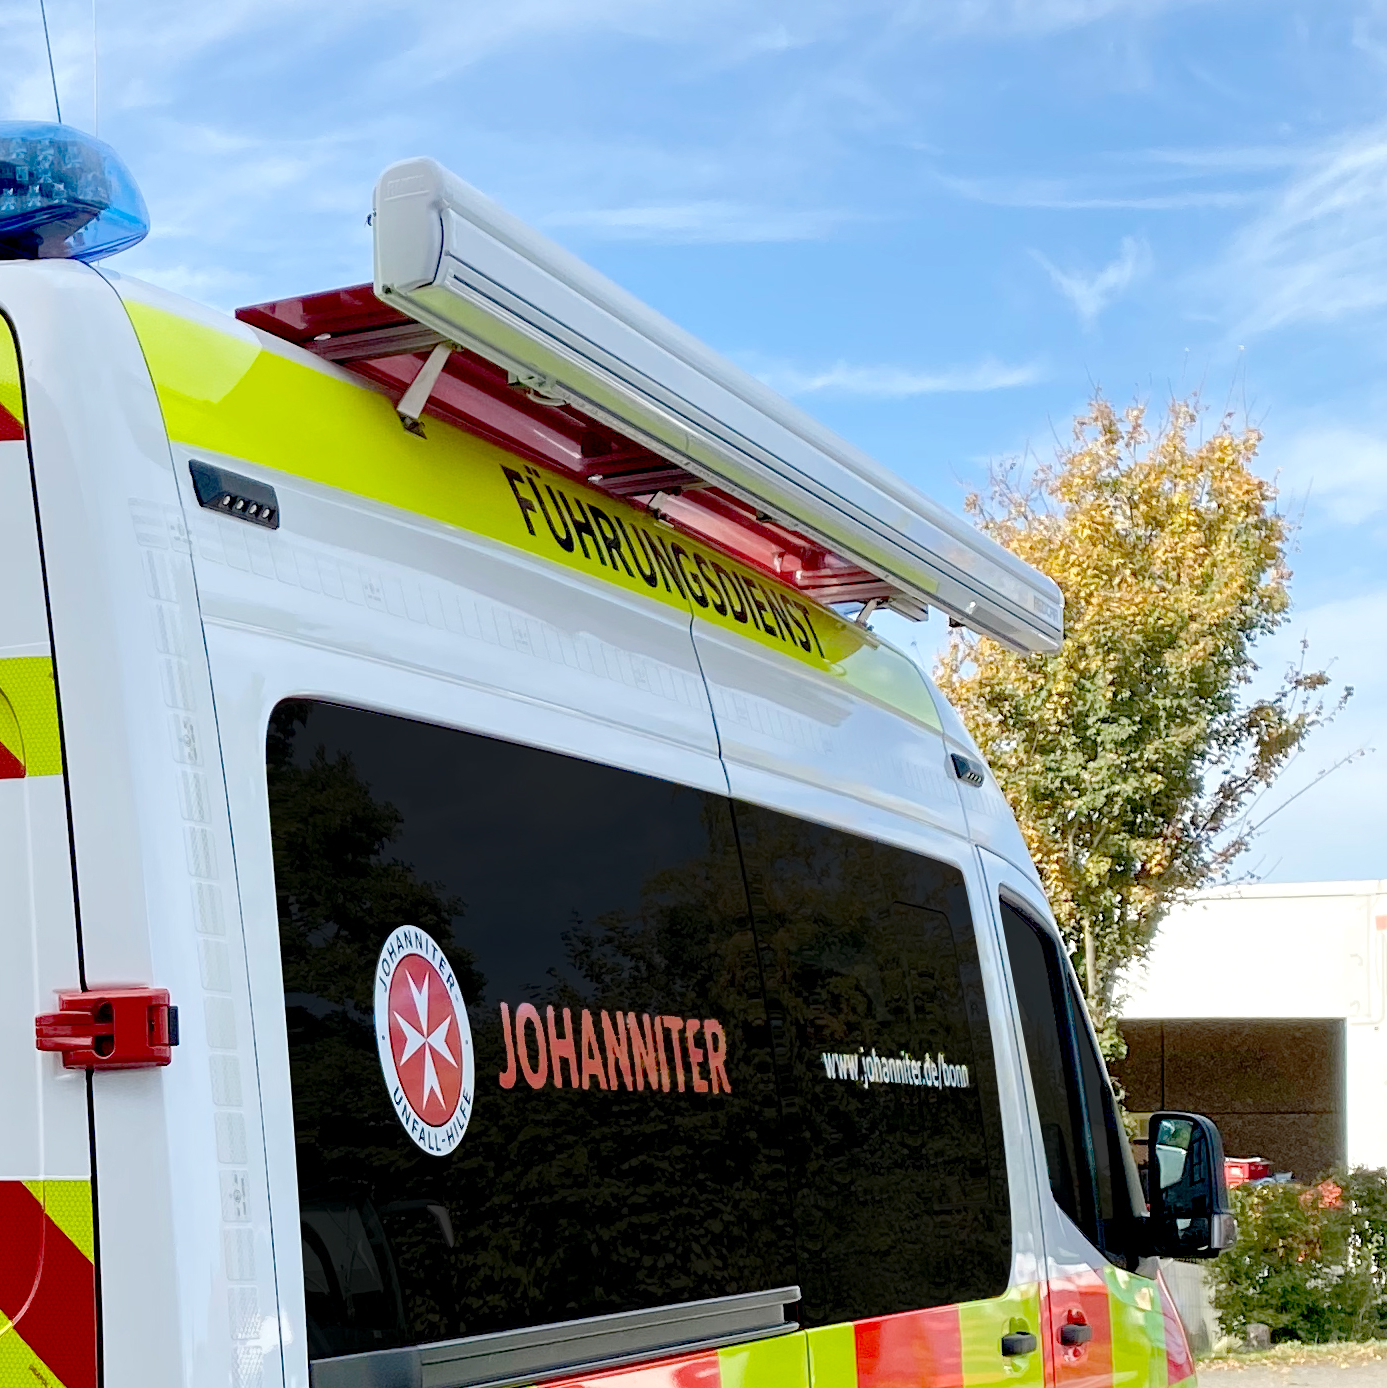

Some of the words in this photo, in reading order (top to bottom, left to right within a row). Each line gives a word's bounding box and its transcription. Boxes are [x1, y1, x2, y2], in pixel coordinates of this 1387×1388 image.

[499, 463, 826, 659] FÜHRUNGSDIENST
[499, 1001, 732, 1095] JOHANNITER
[821, 1046, 970, 1091] www.johanniter.de/bonn
[393, 1085, 472, 1152] UNFALL-HILFE
